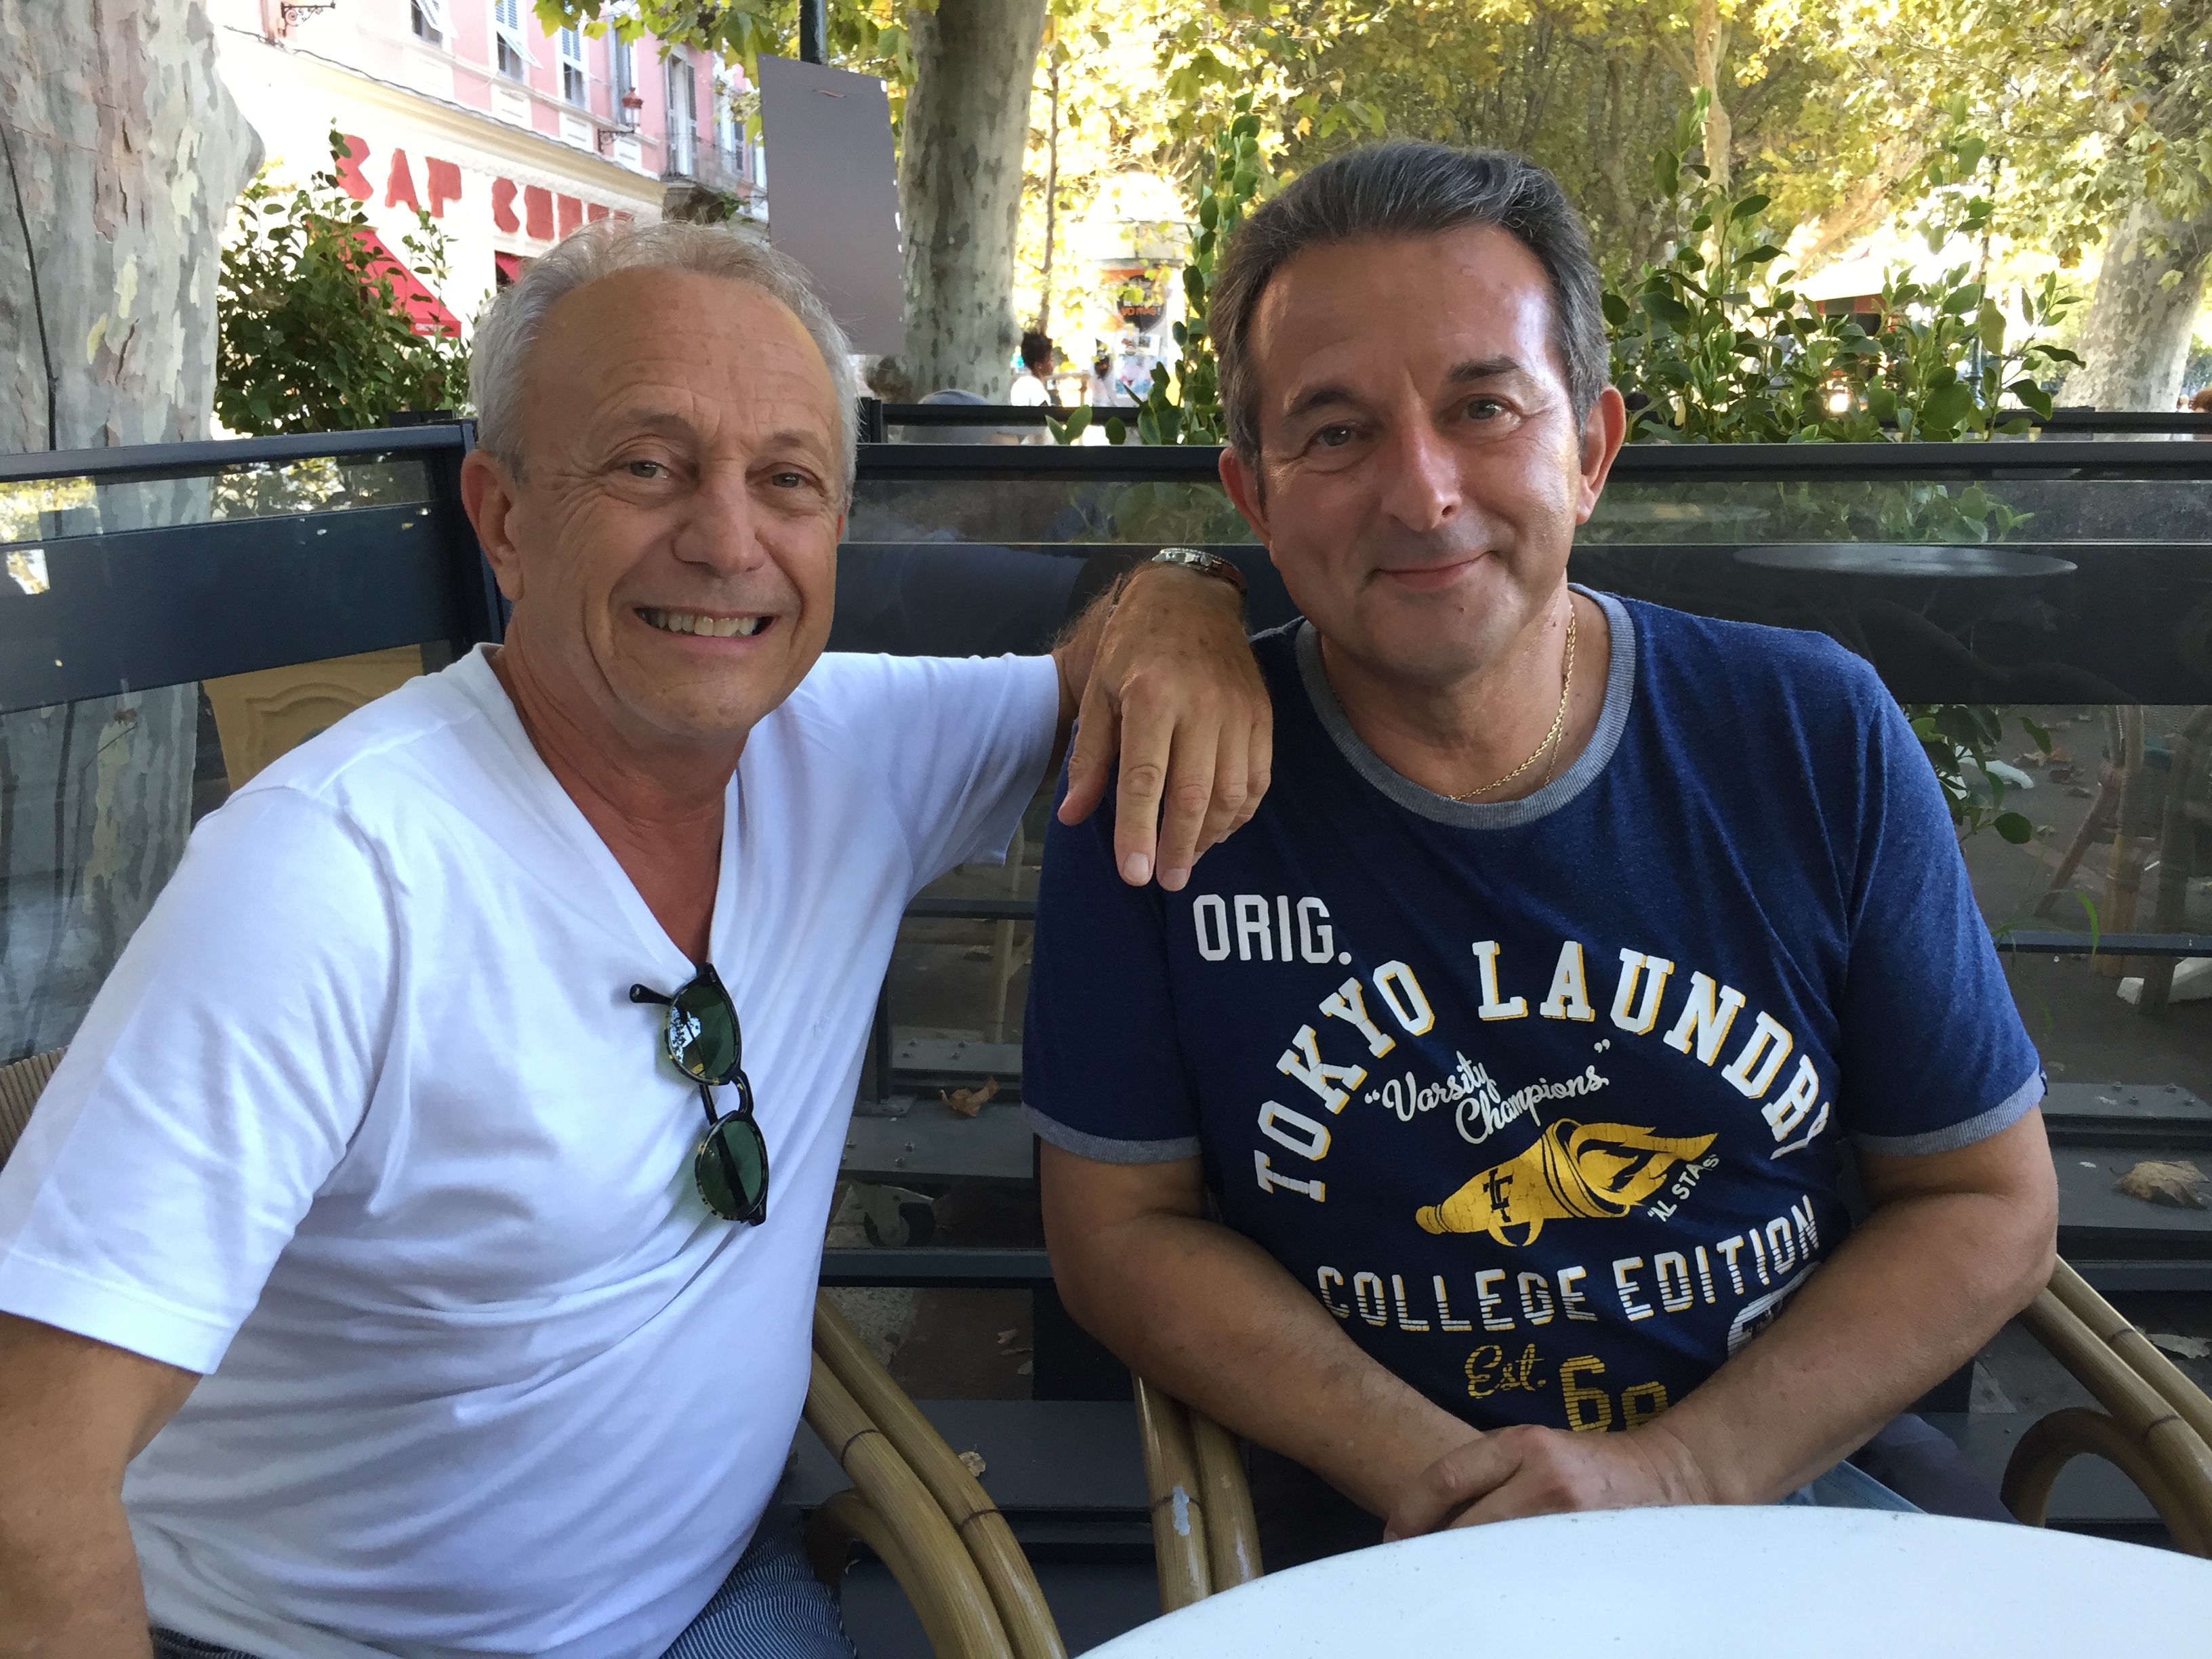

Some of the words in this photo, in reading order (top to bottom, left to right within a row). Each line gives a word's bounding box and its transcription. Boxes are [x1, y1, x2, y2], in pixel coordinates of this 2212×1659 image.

[1192, 893, 1352, 966] ORIG.
[1254, 960, 1435, 1202] TOKYO
[1317, 1265, 1599, 1332] COLLEGE
[1612, 1194, 1820, 1322] EDITION
[1464, 1343, 1547, 1399] Est.
